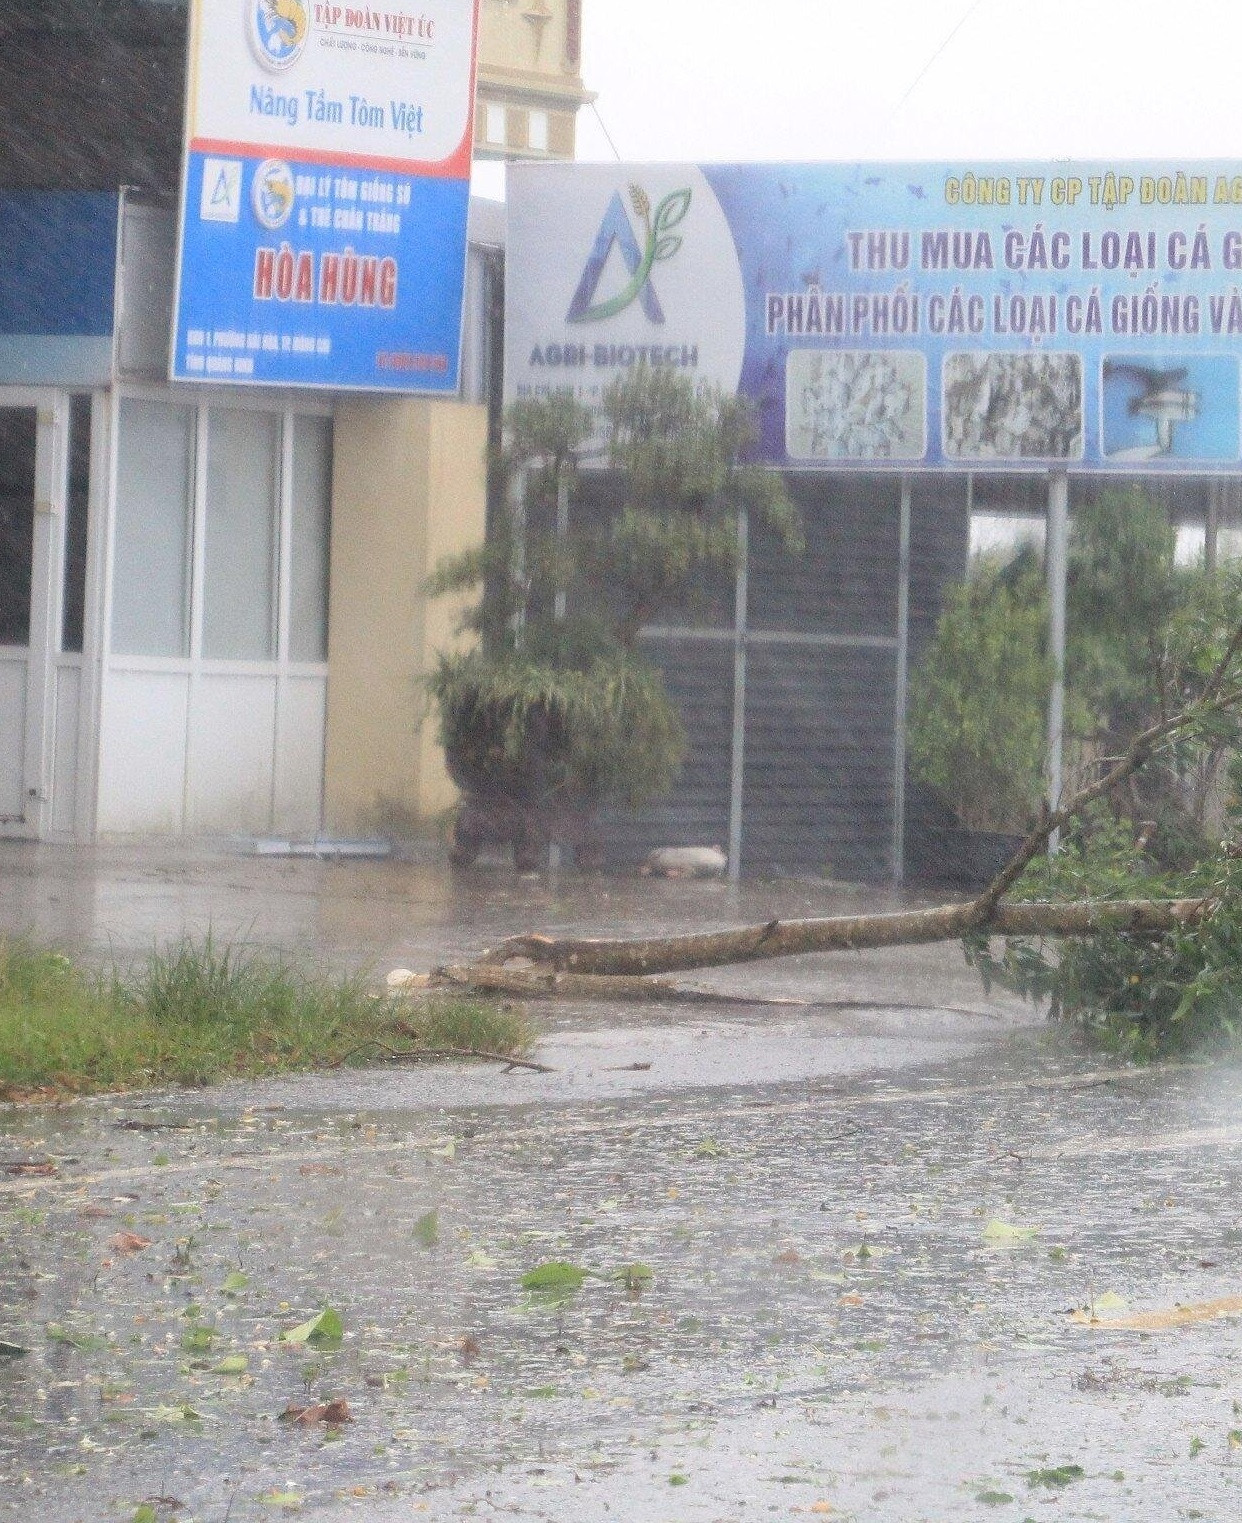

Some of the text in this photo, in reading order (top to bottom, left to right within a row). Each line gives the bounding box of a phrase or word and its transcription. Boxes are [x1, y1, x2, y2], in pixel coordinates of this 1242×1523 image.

[345, 5, 380, 30] ĐOÀN
[384, 11, 414, 39] VIỆT
[418, 13, 434, 38] ÚC
[250, 84, 423, 139] Nâng Tầm Tôm Việt
[945, 171, 1012, 206] CÔNG
[1017, 176, 1045, 206] TY
[1050, 176, 1083, 206] CP
[1088, 171, 1135, 211] TẬP
[1140, 171, 1208, 205] ĐOÀN
[848, 231, 909, 269] THU
[921, 231, 994, 269] MUA
[1005, 223, 1071, 270] CÁC
[1082, 231, 1156, 278] LOẠI
[1167, 223, 1211, 270] CÁ
[852, 281, 919, 333] PHỐI
[928, 286, 984, 333] CÁC
[994, 295, 1056, 342] LOẠI
[1066, 286, 1102, 333] CÁ
[1111, 281, 1200, 333] GIỐNG
